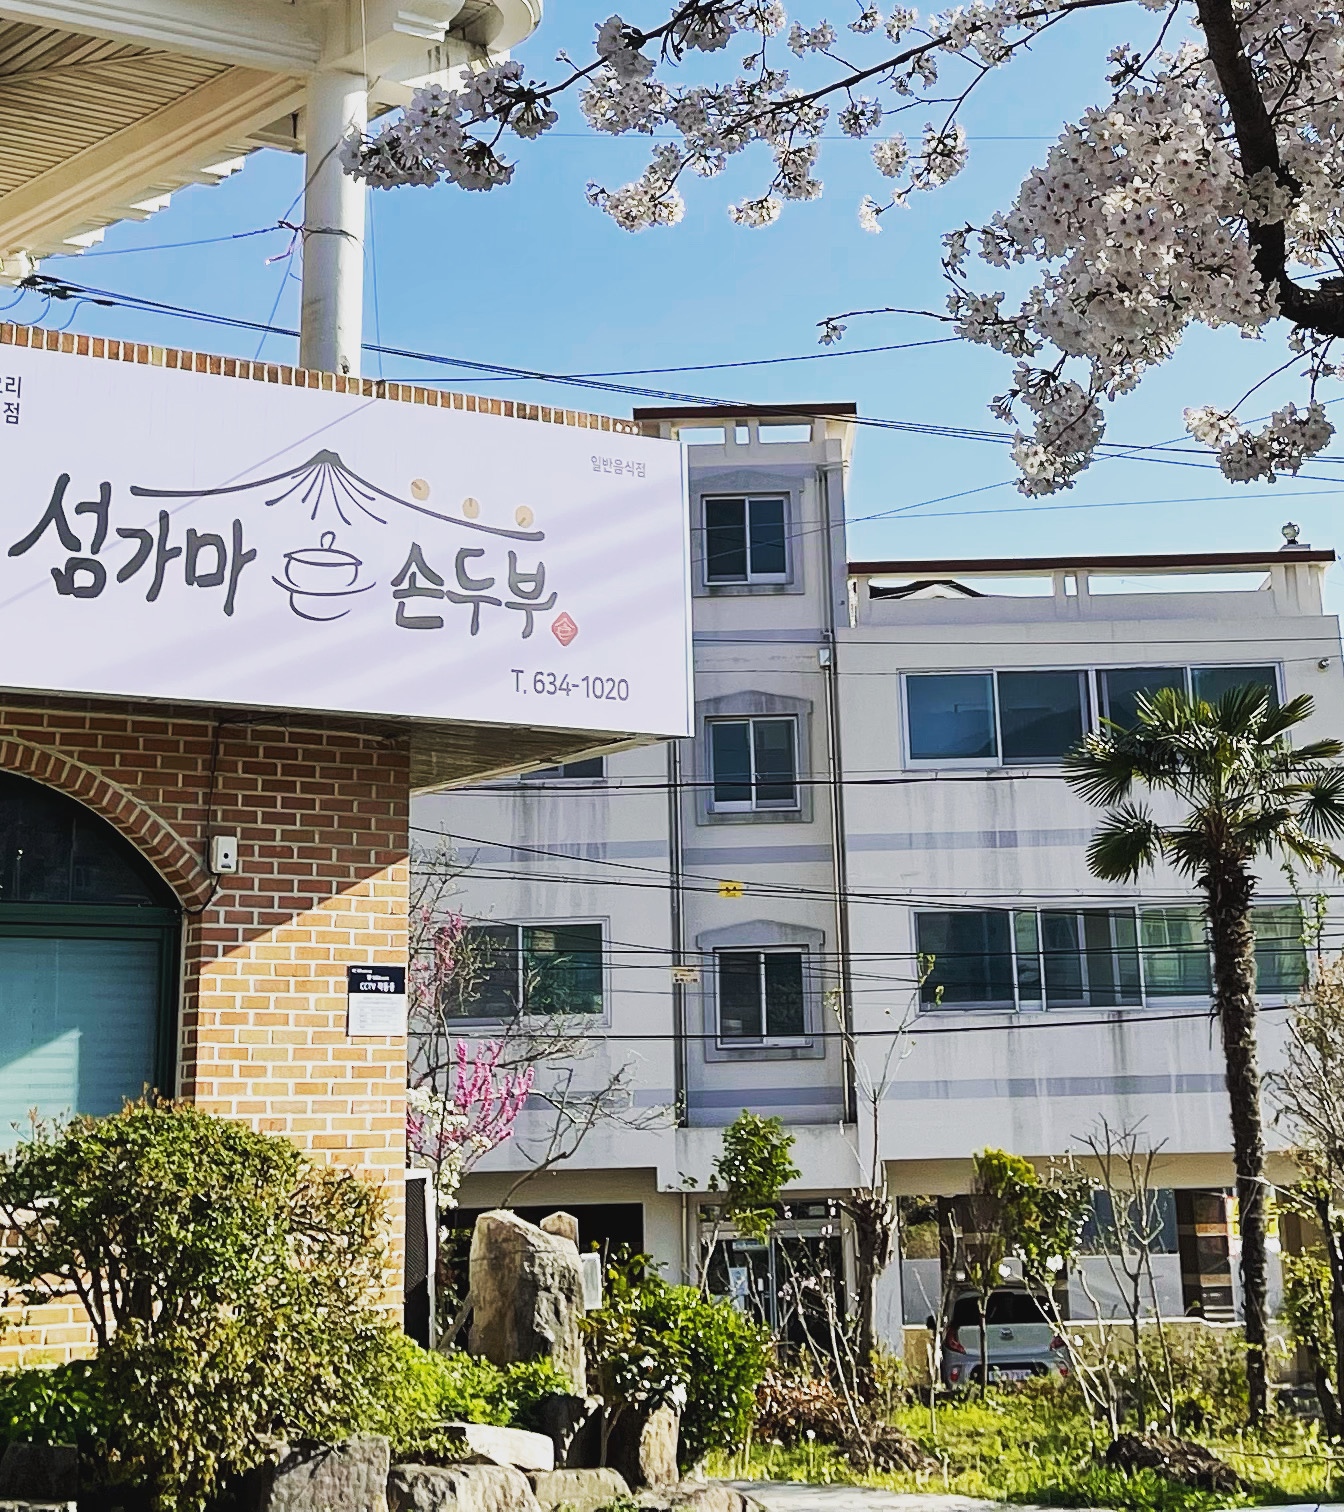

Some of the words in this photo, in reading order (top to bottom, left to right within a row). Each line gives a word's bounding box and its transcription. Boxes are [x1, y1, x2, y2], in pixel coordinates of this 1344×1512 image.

[590, 455, 646, 478] 일반음식점
[8, 472, 257, 616] 섬가마
[392, 542, 558, 639] 손두부
[511, 668, 528, 695] T.
[533, 671, 629, 701] 634-1020
